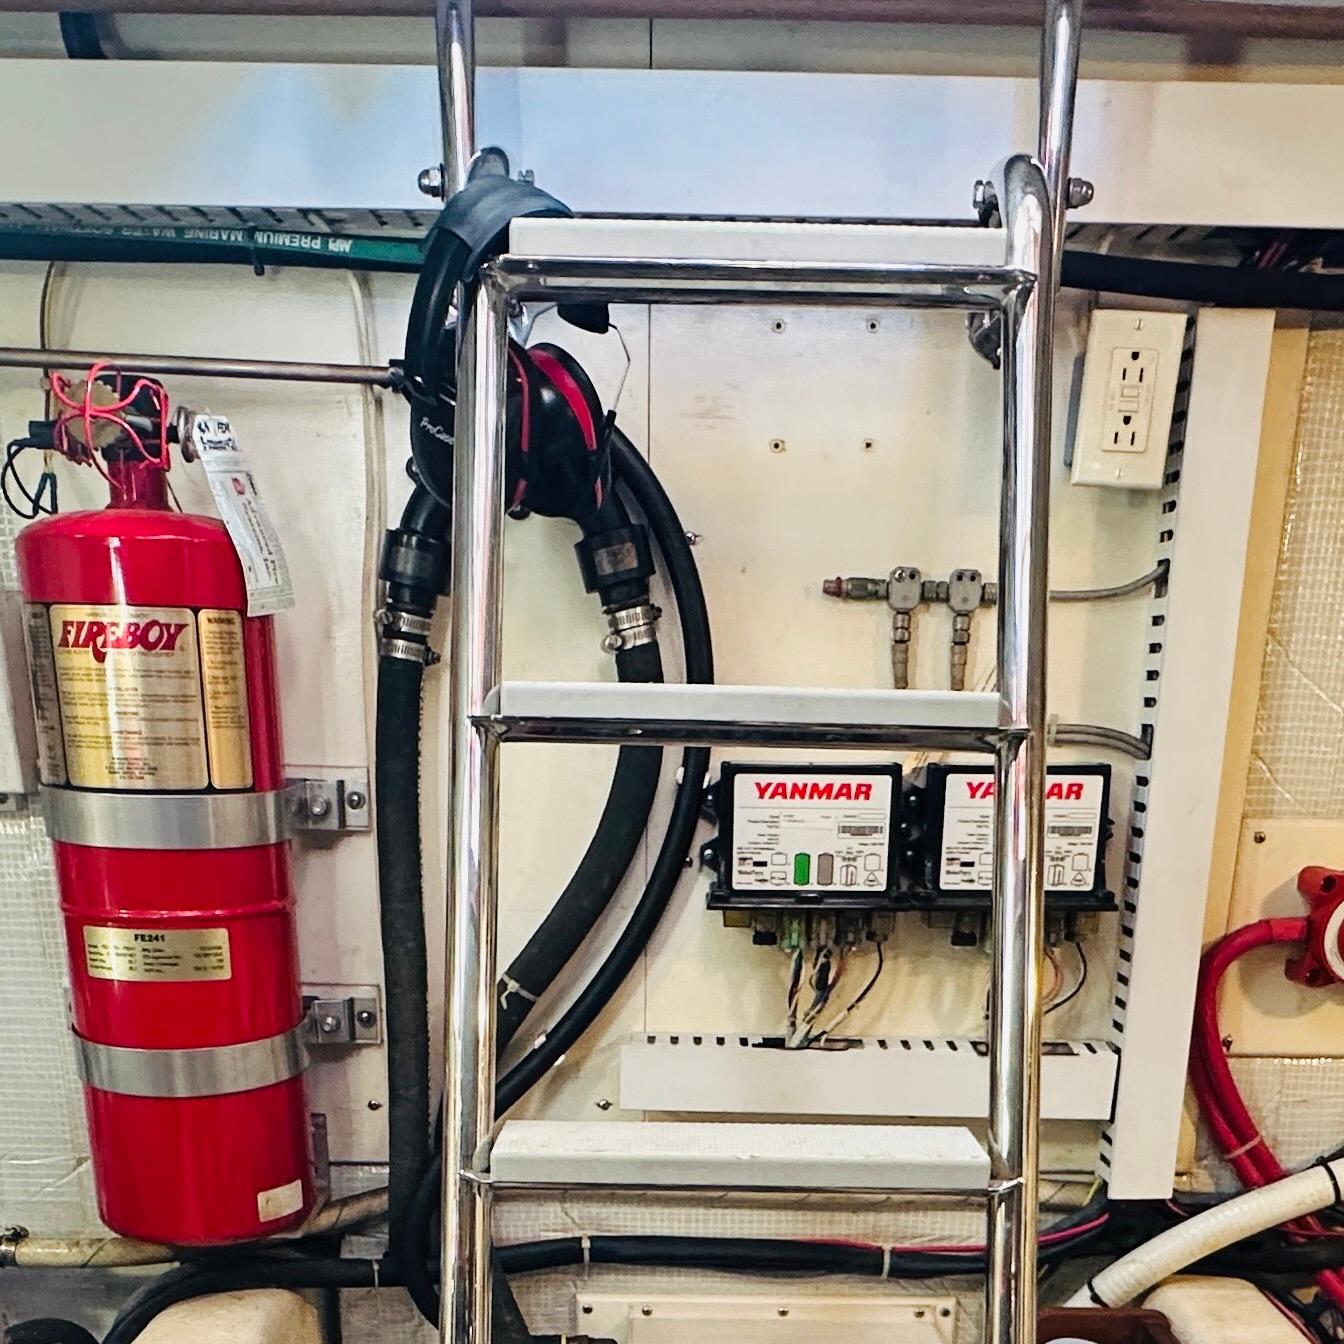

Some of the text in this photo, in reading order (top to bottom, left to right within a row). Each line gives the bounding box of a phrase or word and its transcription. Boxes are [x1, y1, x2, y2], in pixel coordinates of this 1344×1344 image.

[183, 226, 245, 243] MARINE
[58, 619, 189, 663] FIREBOY
[754, 782, 873, 801] YANMAR
[966, 782, 1084, 801] YAAR
[134, 933, 165, 943] FE241
